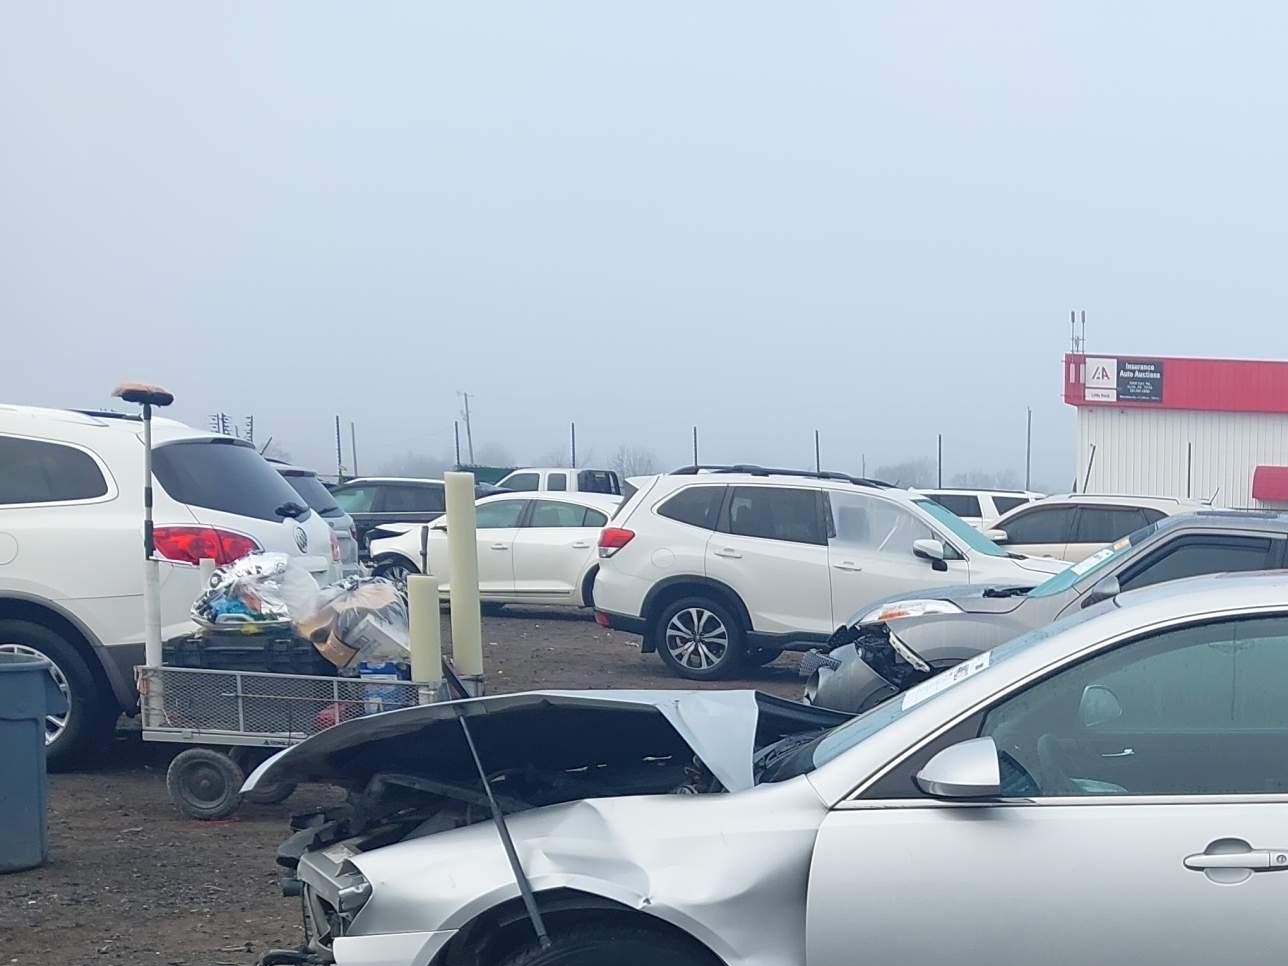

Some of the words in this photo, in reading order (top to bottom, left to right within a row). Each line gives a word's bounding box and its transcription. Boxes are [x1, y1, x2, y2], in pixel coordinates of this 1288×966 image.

[1126, 362, 1155, 371] Insurance
[1120, 370, 1134, 378] Auto
[1135, 370, 1161, 379] Auctions
